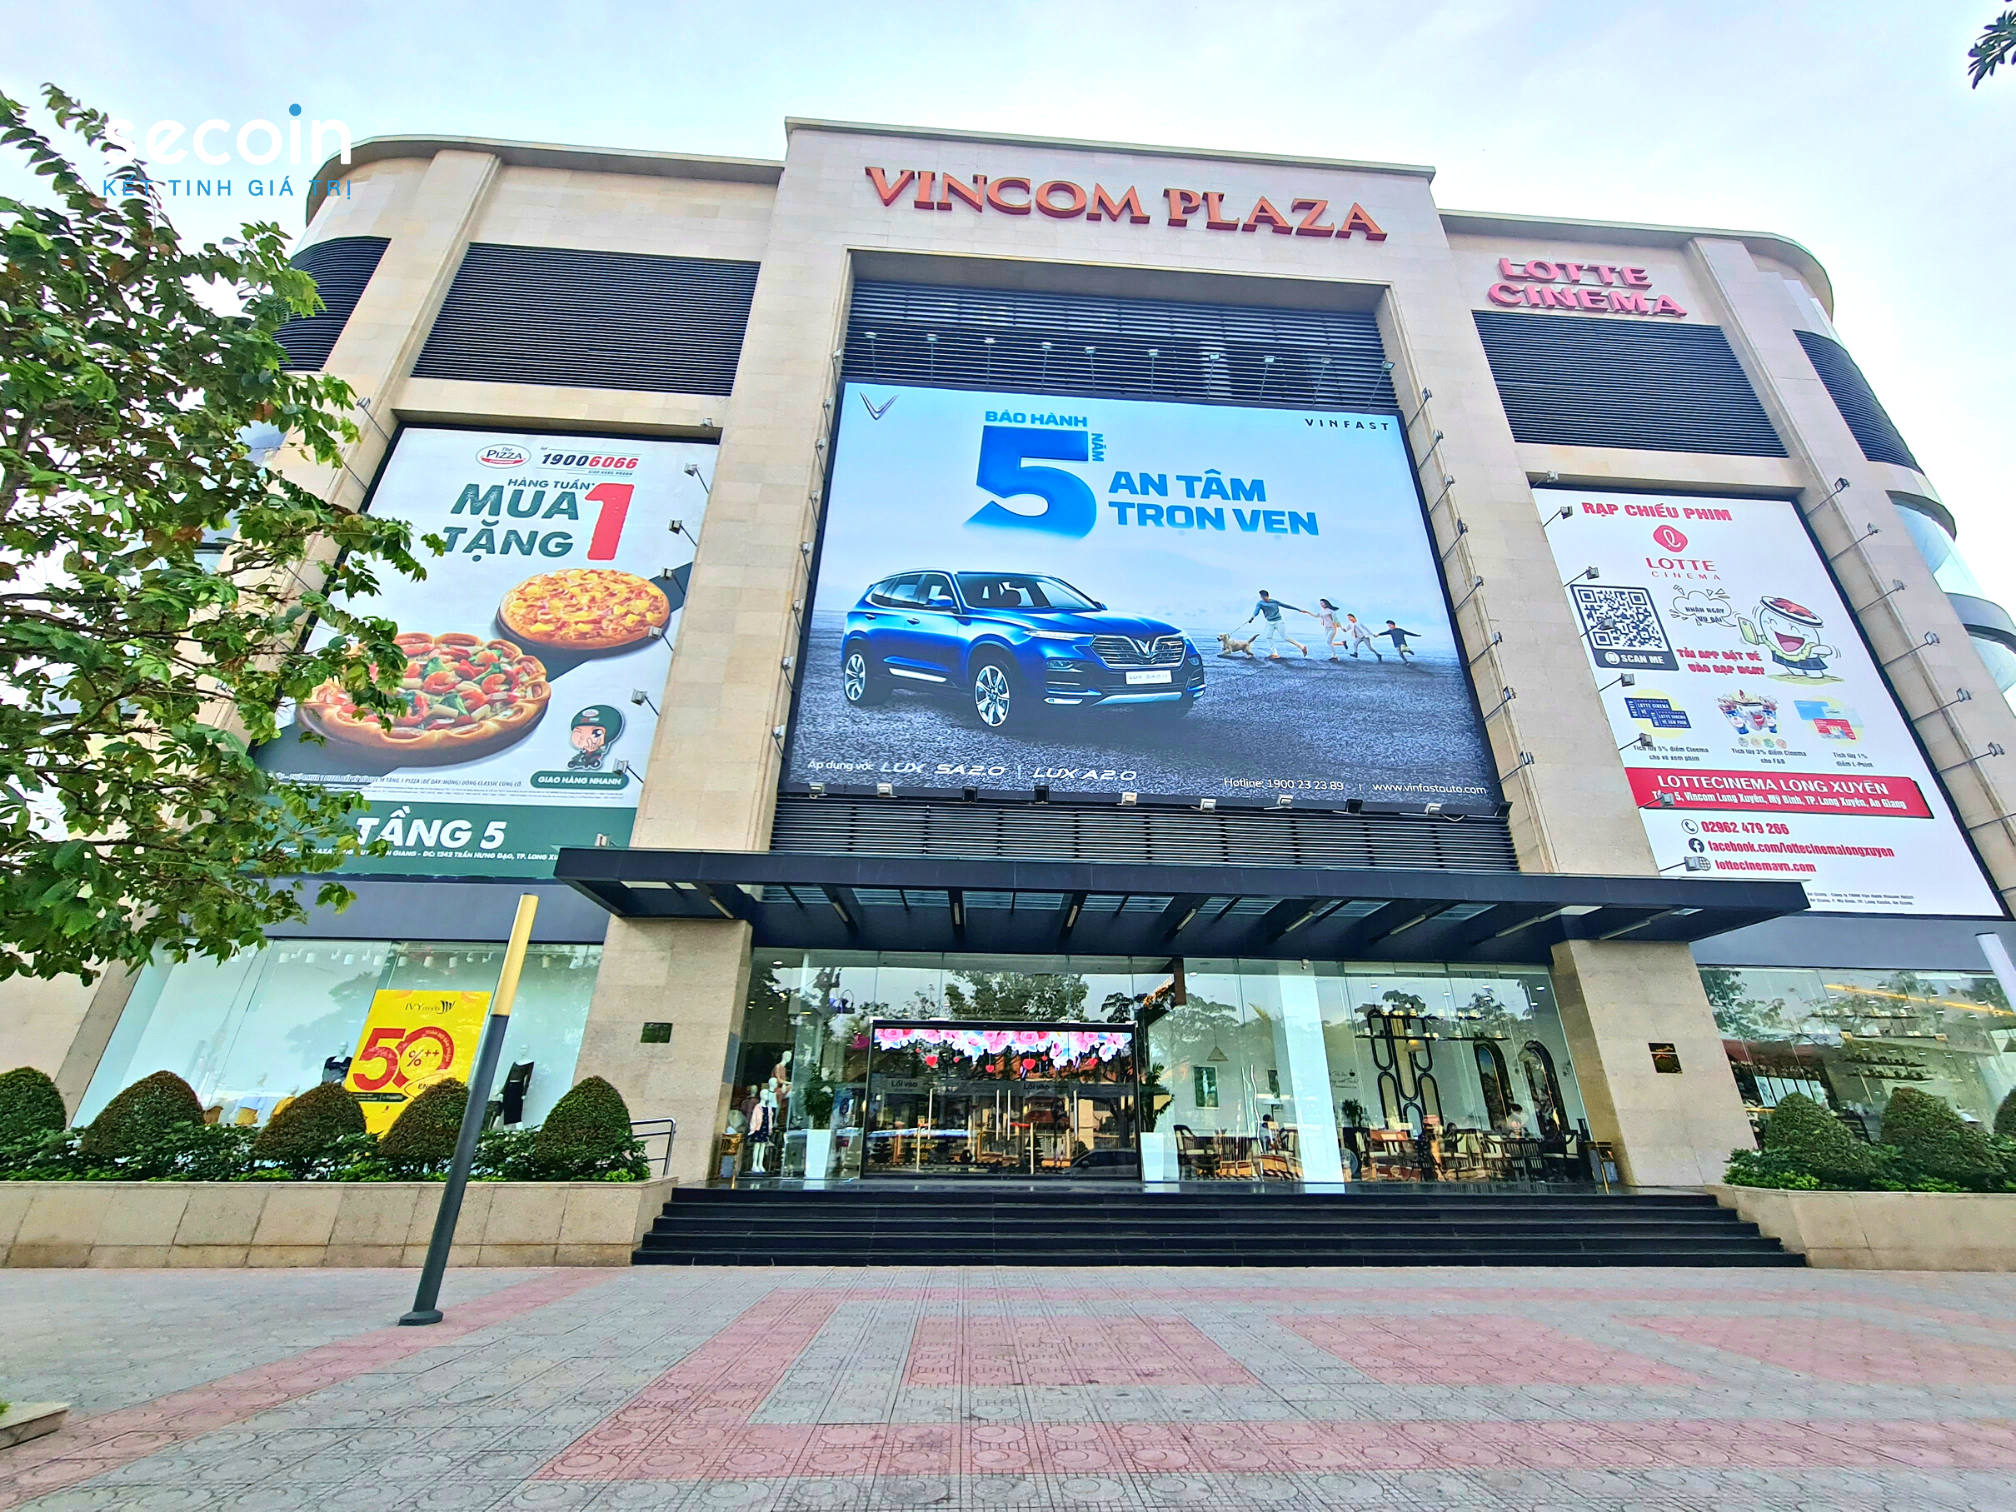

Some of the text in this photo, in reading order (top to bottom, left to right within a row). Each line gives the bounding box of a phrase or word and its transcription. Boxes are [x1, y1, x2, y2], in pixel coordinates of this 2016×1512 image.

[865, 166, 1388, 241] VINCOM PLAZA
[1499, 258, 1653, 290] LOTTE
[1488, 283, 1687, 319] CINEMA
[1030, 411, 1088, 427] HÀNH
[1304, 418, 1389, 431] VINFAST
[486, 450, 522, 460] PIZZA
[541, 453, 639, 469] 19006066
[508, 477, 548, 488] HÀNG
[962, 425, 1097, 541] 5
[1108, 468, 1266, 502] AN TÂM
[1581, 502, 1733, 521] RẠP CHIẾU PHIM
[450, 483, 635, 561] MUA 1
[443, 519, 574, 562] TẶNG
[1646, 557, 1717, 573] LOTTE
[1651, 571, 1721, 581] CINEMA
[1620, 654, 1664, 664] SCAN ME
[1698, 650, 1719, 659] APP
[538, 775, 622, 785] GIAO HÀNG NHANH
[880, 762, 924, 773] LUX
[934, 764, 1005, 776] SA2.0
[1033, 767, 1078, 778] LUX
[1082, 769, 1137, 781] A2.0
[1224, 778, 1487, 795] Hotline: 1900 23 23 89 www.vinfastauto.com
[1657, 775, 1890, 795] LOTTECINEMA LONG XUYÊN
[1684, 792, 1715, 801] Vincom
[1716, 793, 1738, 803] Long
[1804, 796, 1818, 805] TP.
[1819, 797, 1840, 807] Long
[1870, 798, 1881, 808] An
[1883, 799, 1907, 809] Giang
[356, 805, 507, 850] TẦNG 5
[1701, 821, 1790, 836] 02962 479 266
[1715, 859, 1817, 873] lottecinemavn.com
